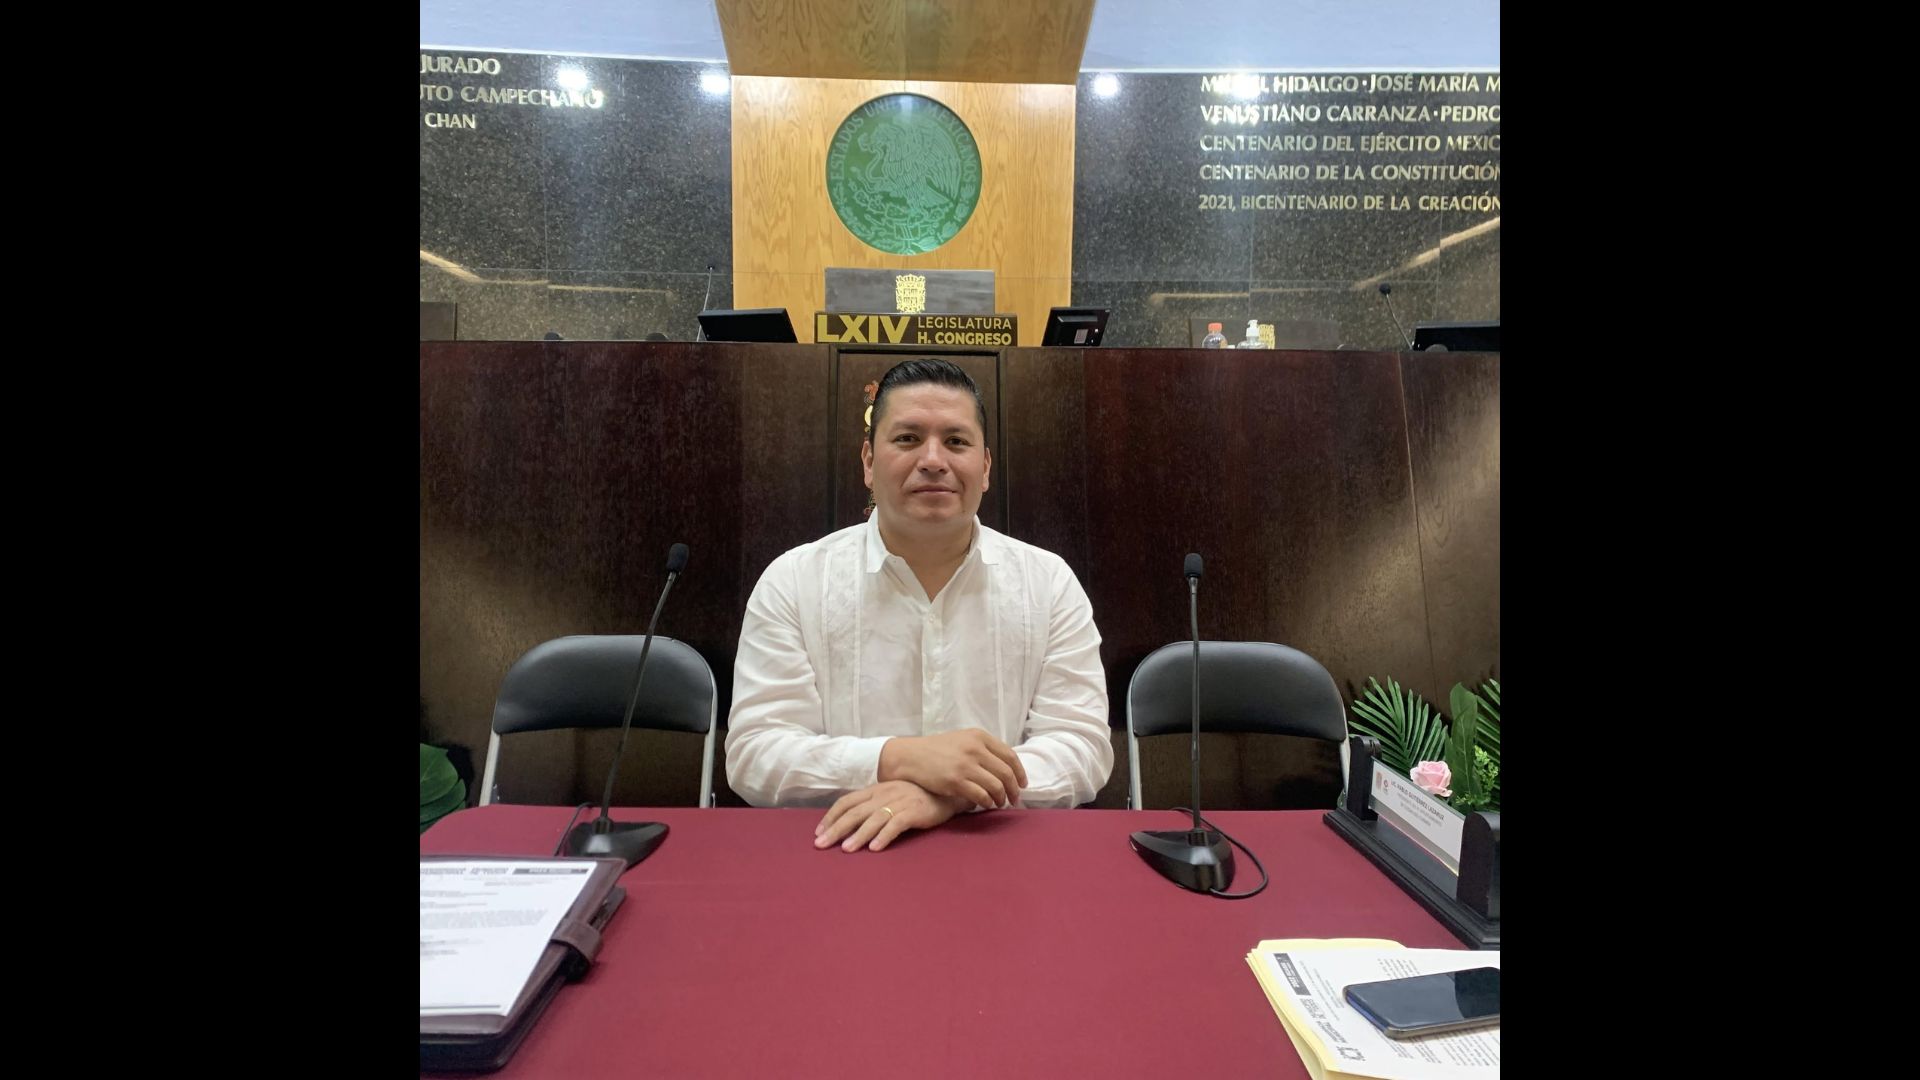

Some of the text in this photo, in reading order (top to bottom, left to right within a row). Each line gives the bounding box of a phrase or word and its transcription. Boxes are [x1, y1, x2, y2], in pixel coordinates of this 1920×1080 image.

[420, 54, 501, 75] JURADO
[1273, 75, 1359, 93] HIDALGO
[1368, 73, 1413, 93] JOSÉ
[1418, 72, 1480, 92] MARÍA
[1485, 75, 1500, 92] M
[461, 85, 605, 109] CAMPECHANO
[424, 112, 476, 129] CHAN
[1200, 104, 1500, 124] VENUSTIANO CARRANZA PEDRO
[830, 116, 864, 180] ESTADOS
[927, 102, 978, 183] MEXICANOS
[1200, 134, 1317, 152] CENTENARIO
[1322, 135, 1355, 152] DEL
[1360, 132, 1440, 154] EJÉRCITO
[1200, 164, 1310, 180] CENTENARIO
[1316, 164, 1339, 180] DE
[1344, 164, 1365, 180] LA
[1198, 194, 1236, 212] 2021,
[1240, 195, 1357, 210] BICENTENARIO
[1363, 195, 1385, 211] DE
[1390, 195, 1411, 211] LA
[817, 314, 911, 344] LXIV
[917, 316, 1012, 330] LEGISLATURA
[917, 331, 1012, 346] H. CONGRESO
